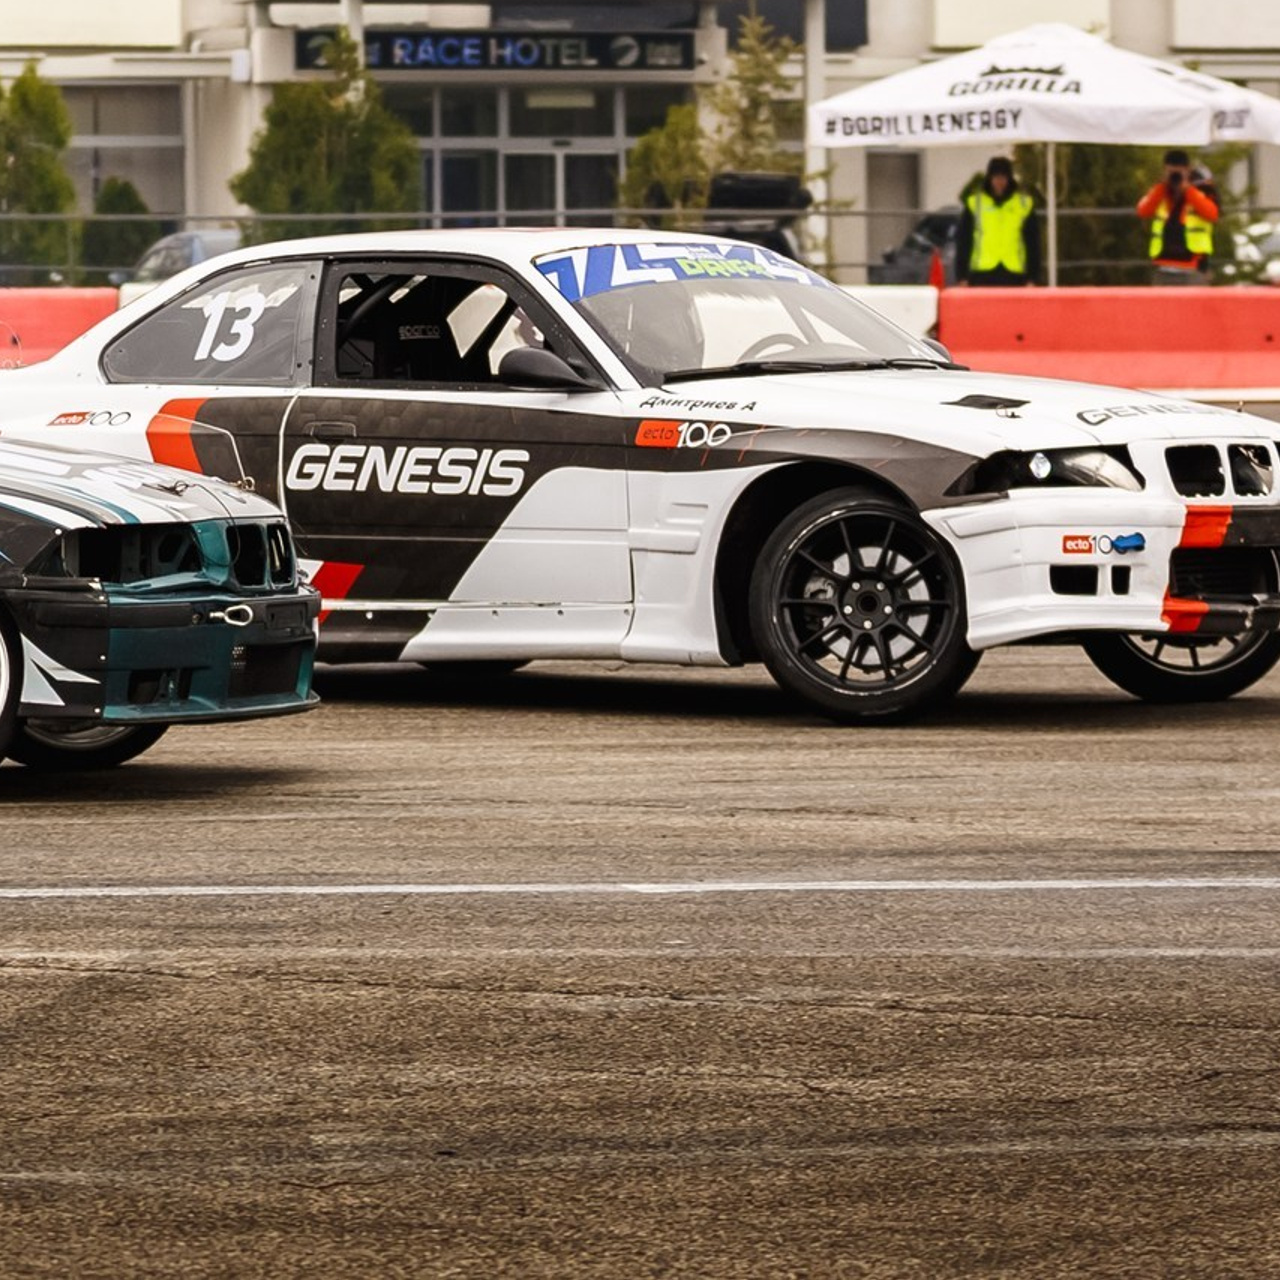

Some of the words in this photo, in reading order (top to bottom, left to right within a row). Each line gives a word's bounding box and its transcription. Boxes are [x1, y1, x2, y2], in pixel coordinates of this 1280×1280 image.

[392, 38, 483, 65] RACE
[489, 38, 598, 65] HOTEL
[947, 78, 1083, 98] GORILLA
[194, 291, 266, 362] 13
[285, 443, 531, 497] GENESIS
